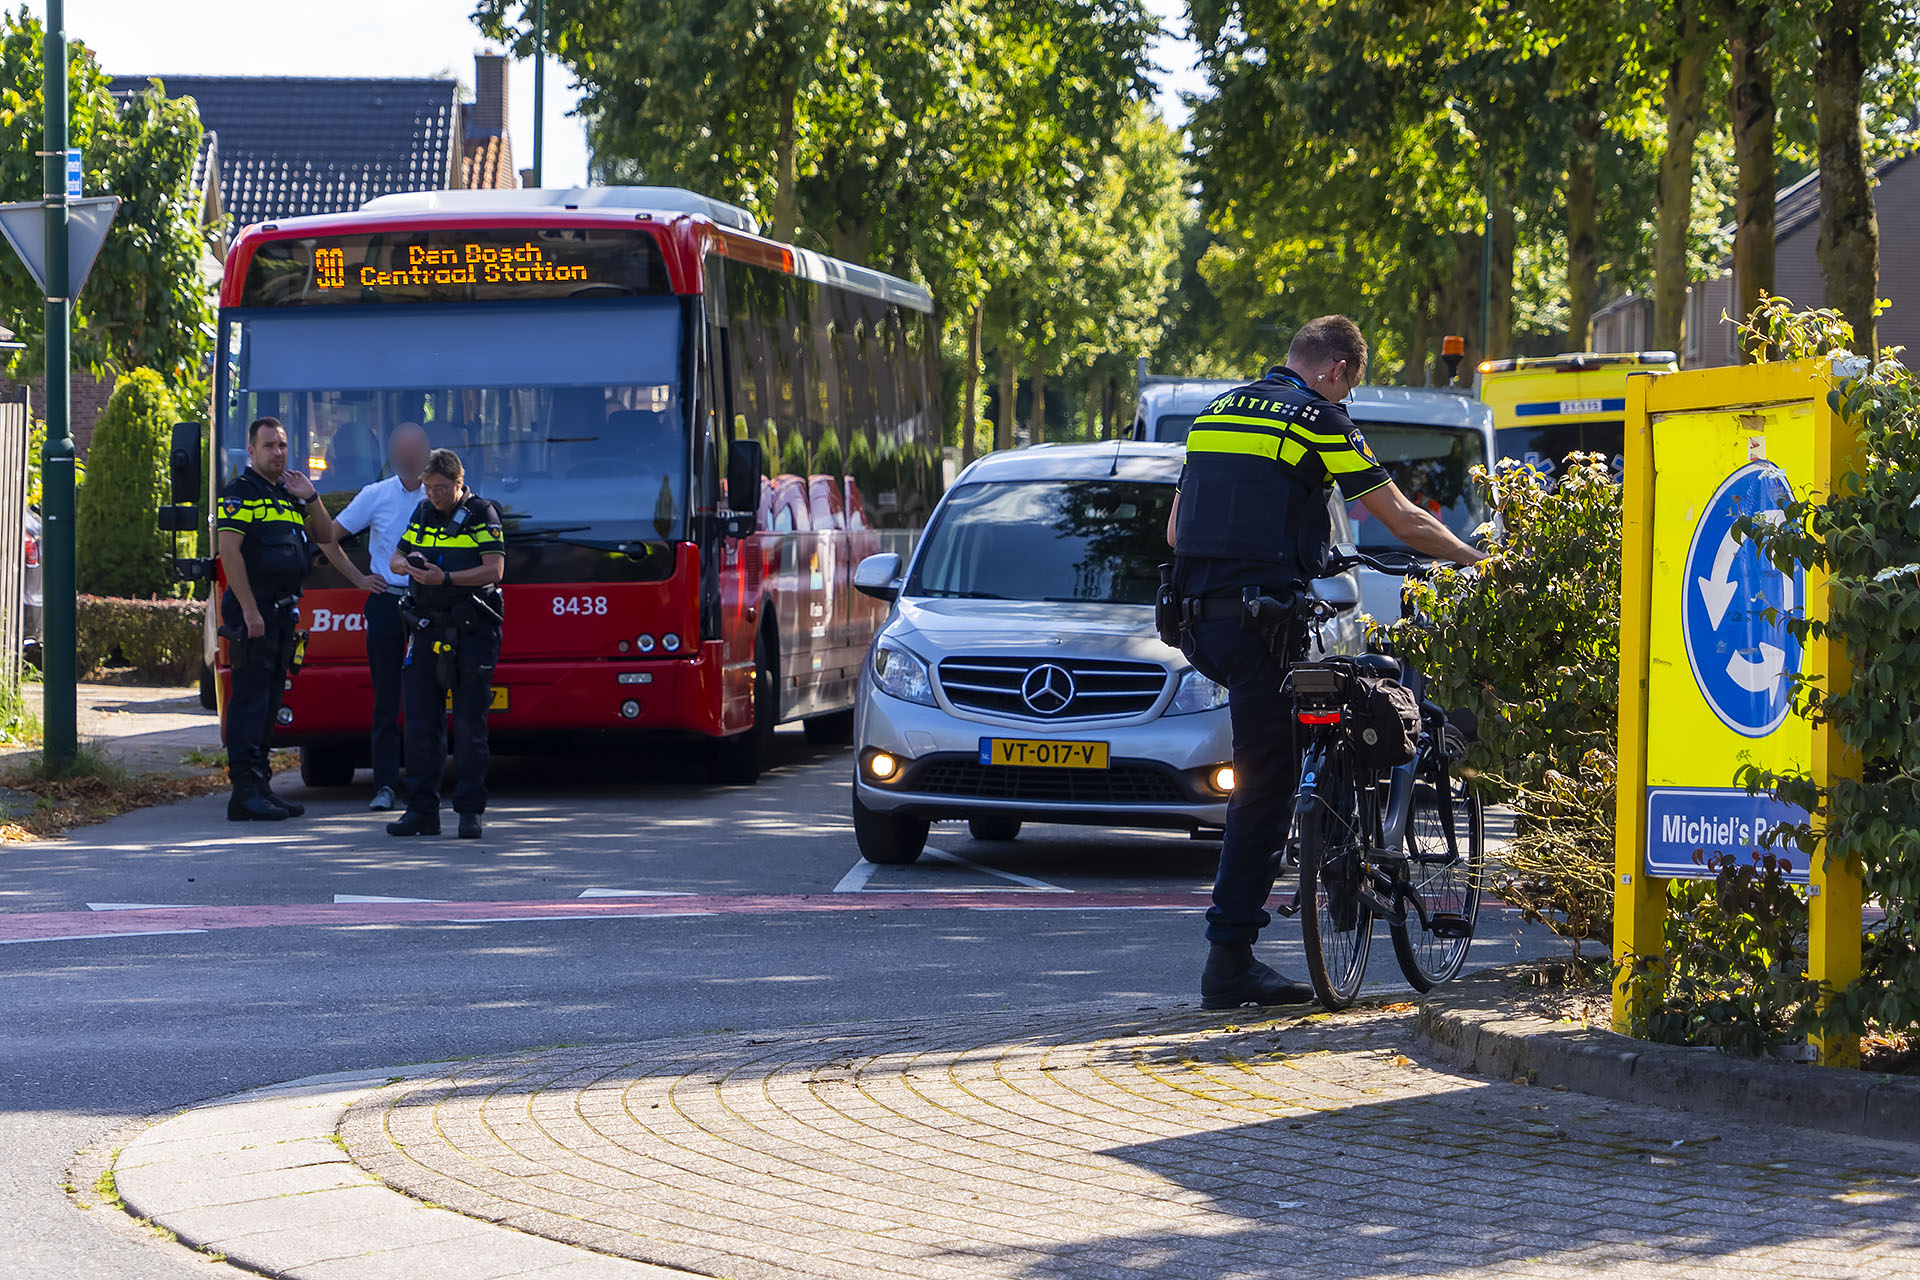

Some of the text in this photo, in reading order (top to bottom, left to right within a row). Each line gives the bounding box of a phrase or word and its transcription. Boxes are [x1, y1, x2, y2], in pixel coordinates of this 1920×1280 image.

[408, 242, 542, 264] Den Bosch
[315, 248, 344, 288] 90
[360, 261, 587, 286] Centraal Station
[552, 596, 608, 615] 8438
[1002, 742, 1095, 764] VT-017-V
[1662, 814, 1750, 846] Michiel's
